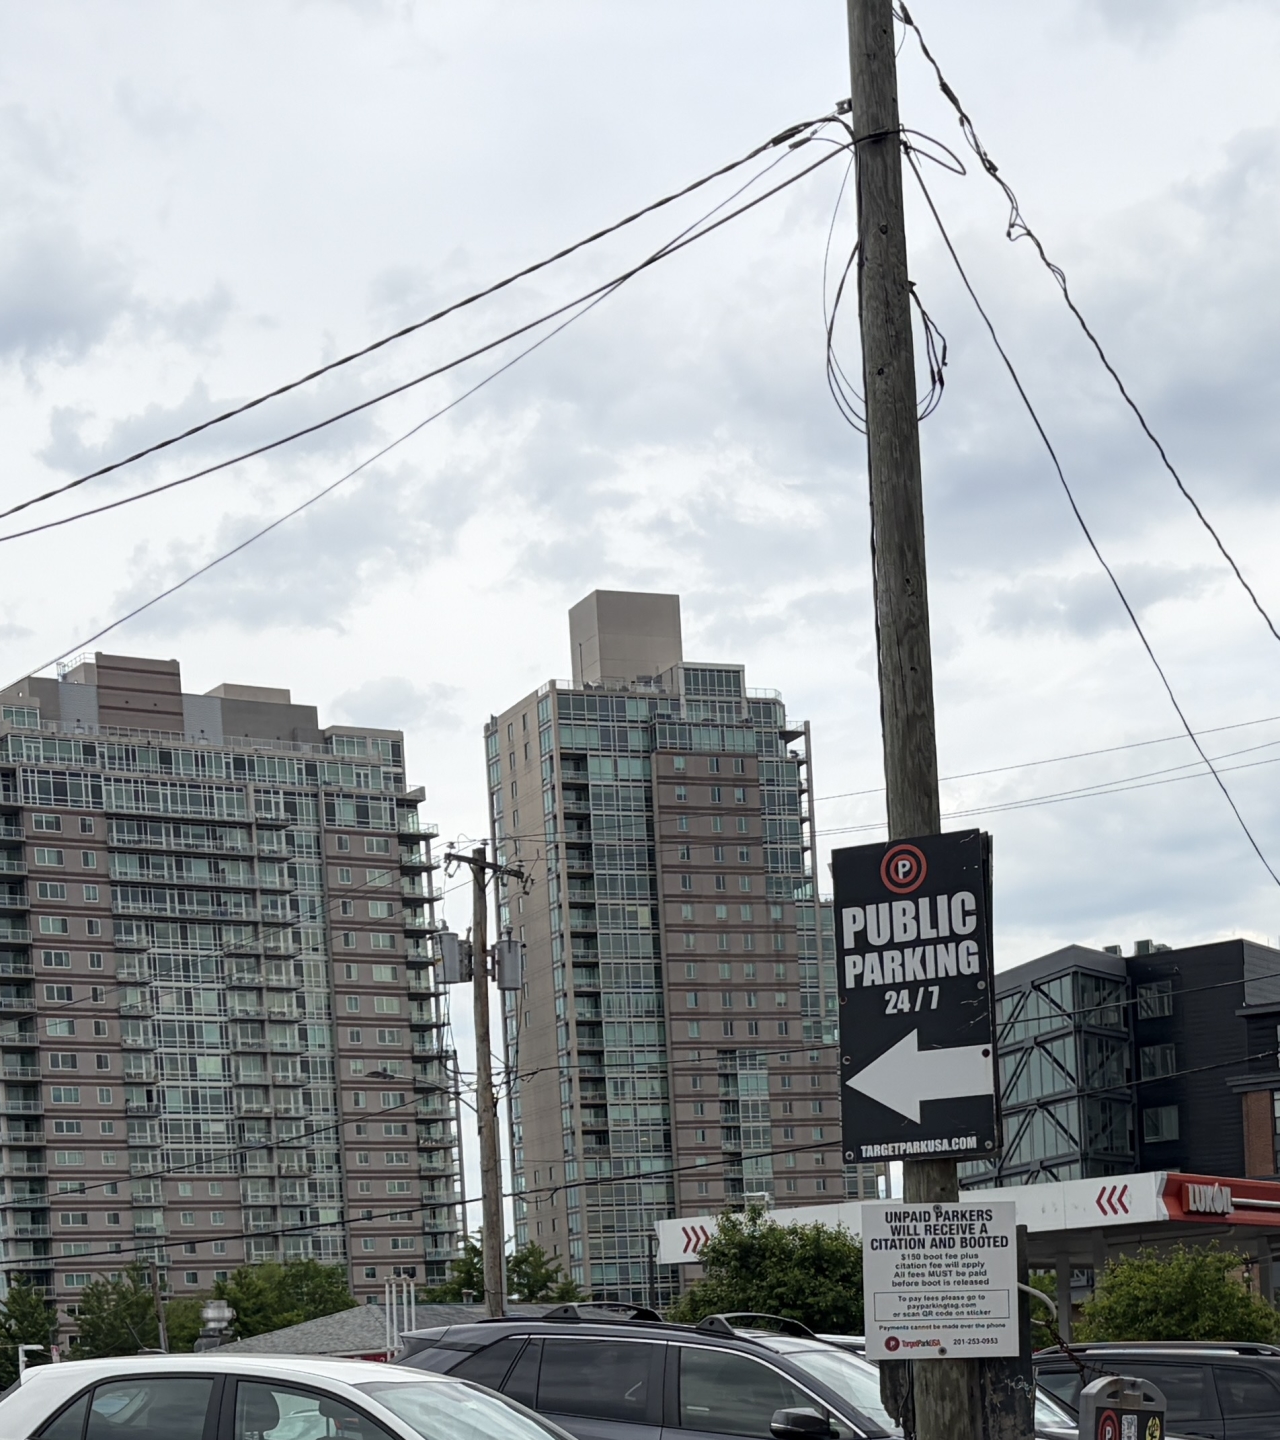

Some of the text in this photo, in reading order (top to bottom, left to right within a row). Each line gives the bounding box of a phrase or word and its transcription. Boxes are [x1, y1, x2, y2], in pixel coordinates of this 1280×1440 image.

[898, 859, 910, 879] P
[842, 891, 976, 949] PUBLIC
[844, 940, 980, 989] PARKING
[861, 1136, 977, 1158] TARGETPARKUSA.COM
[1187, 1183, 1234, 1213] LUKOIL
[885, 1209, 992, 1223] UNPAID PARKERS
[890, 1223, 988, 1236] WILL RECEIVE A
[871, 1236, 1008, 1251] CITATION AND BOOTED
[901, 1253, 920, 1261] $150
[961, 1252, 978, 1261] plus
[962, 1261, 985, 1269] apply
[969, 1270, 987, 1278] paid
